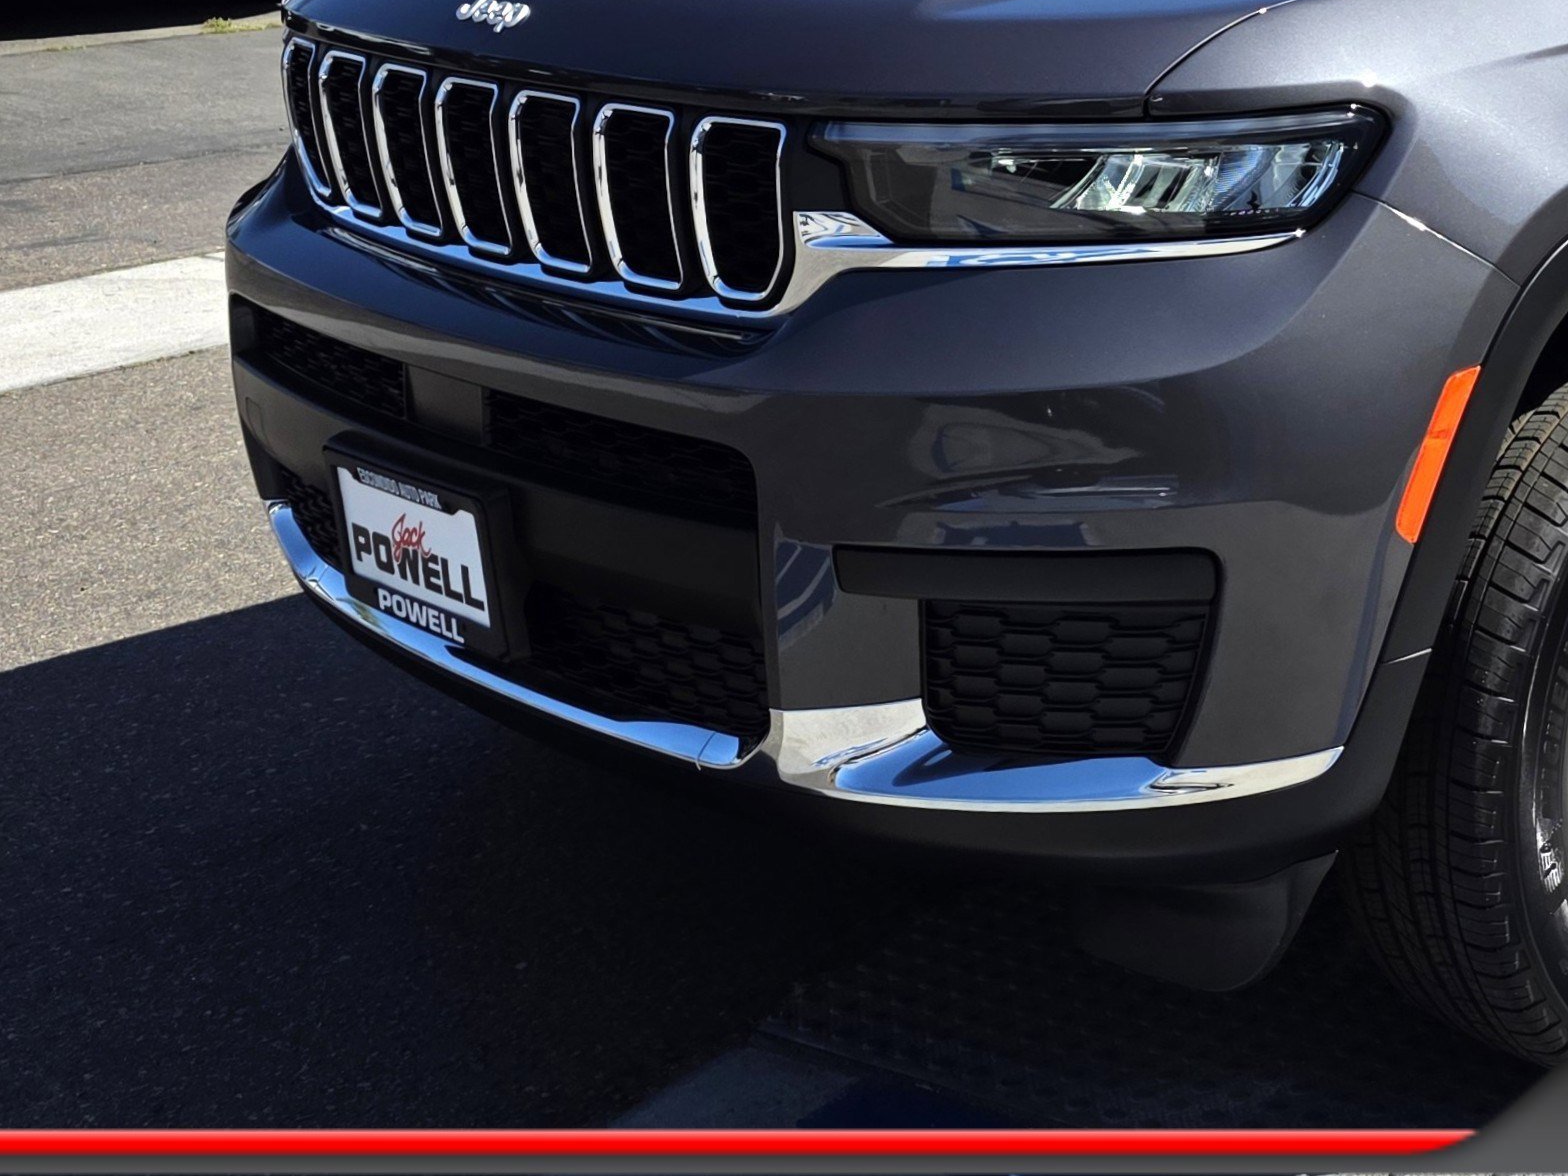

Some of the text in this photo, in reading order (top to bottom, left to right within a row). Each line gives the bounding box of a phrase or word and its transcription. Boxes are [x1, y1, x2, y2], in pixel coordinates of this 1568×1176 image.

[352, 522, 485, 612] POWELL
[391, 512, 432, 565] Jack
[377, 587, 465, 644] POWELL
